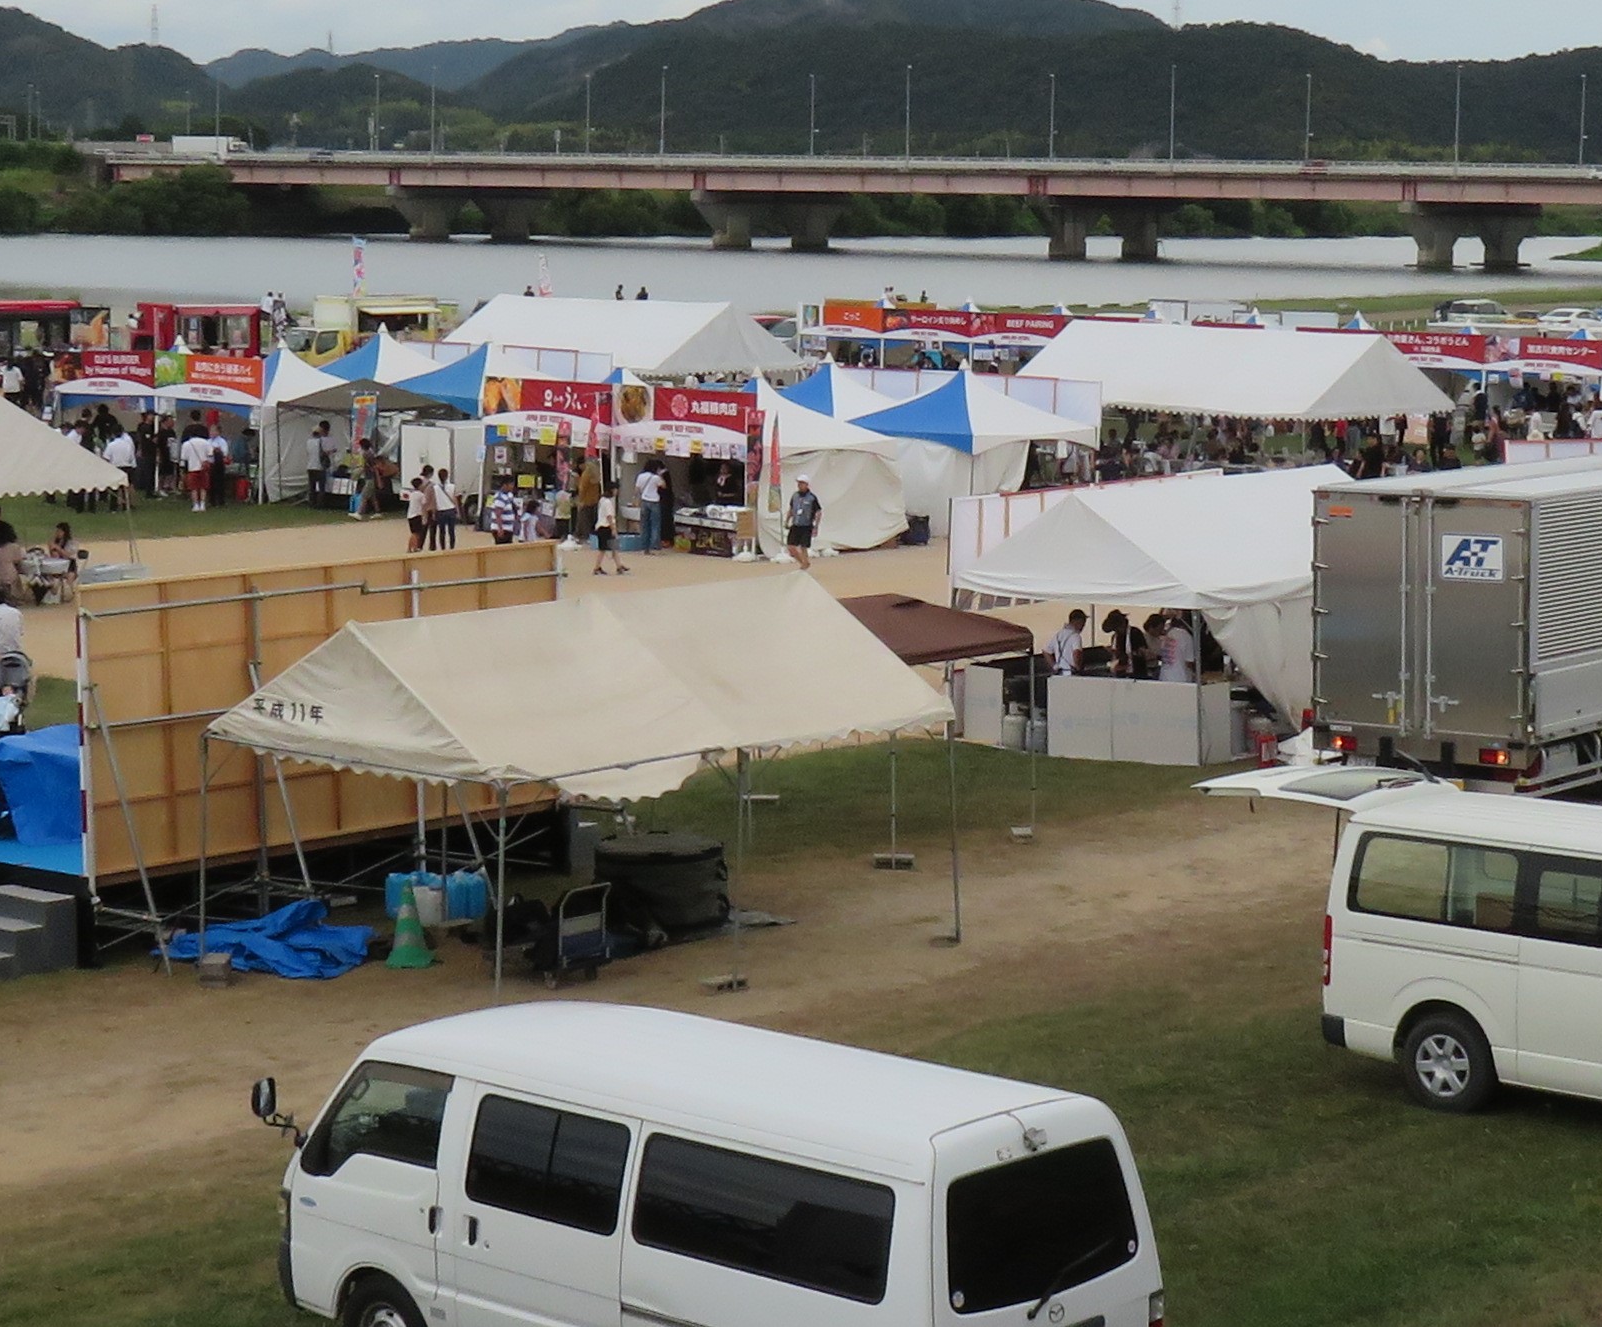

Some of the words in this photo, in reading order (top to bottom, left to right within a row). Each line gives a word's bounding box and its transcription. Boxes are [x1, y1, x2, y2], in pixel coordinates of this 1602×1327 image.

[1006, 318, 1023, 329] BEEF
[1444, 567, 1498, 577] A-Truck
[253, 697, 324, 725] 平成11年
